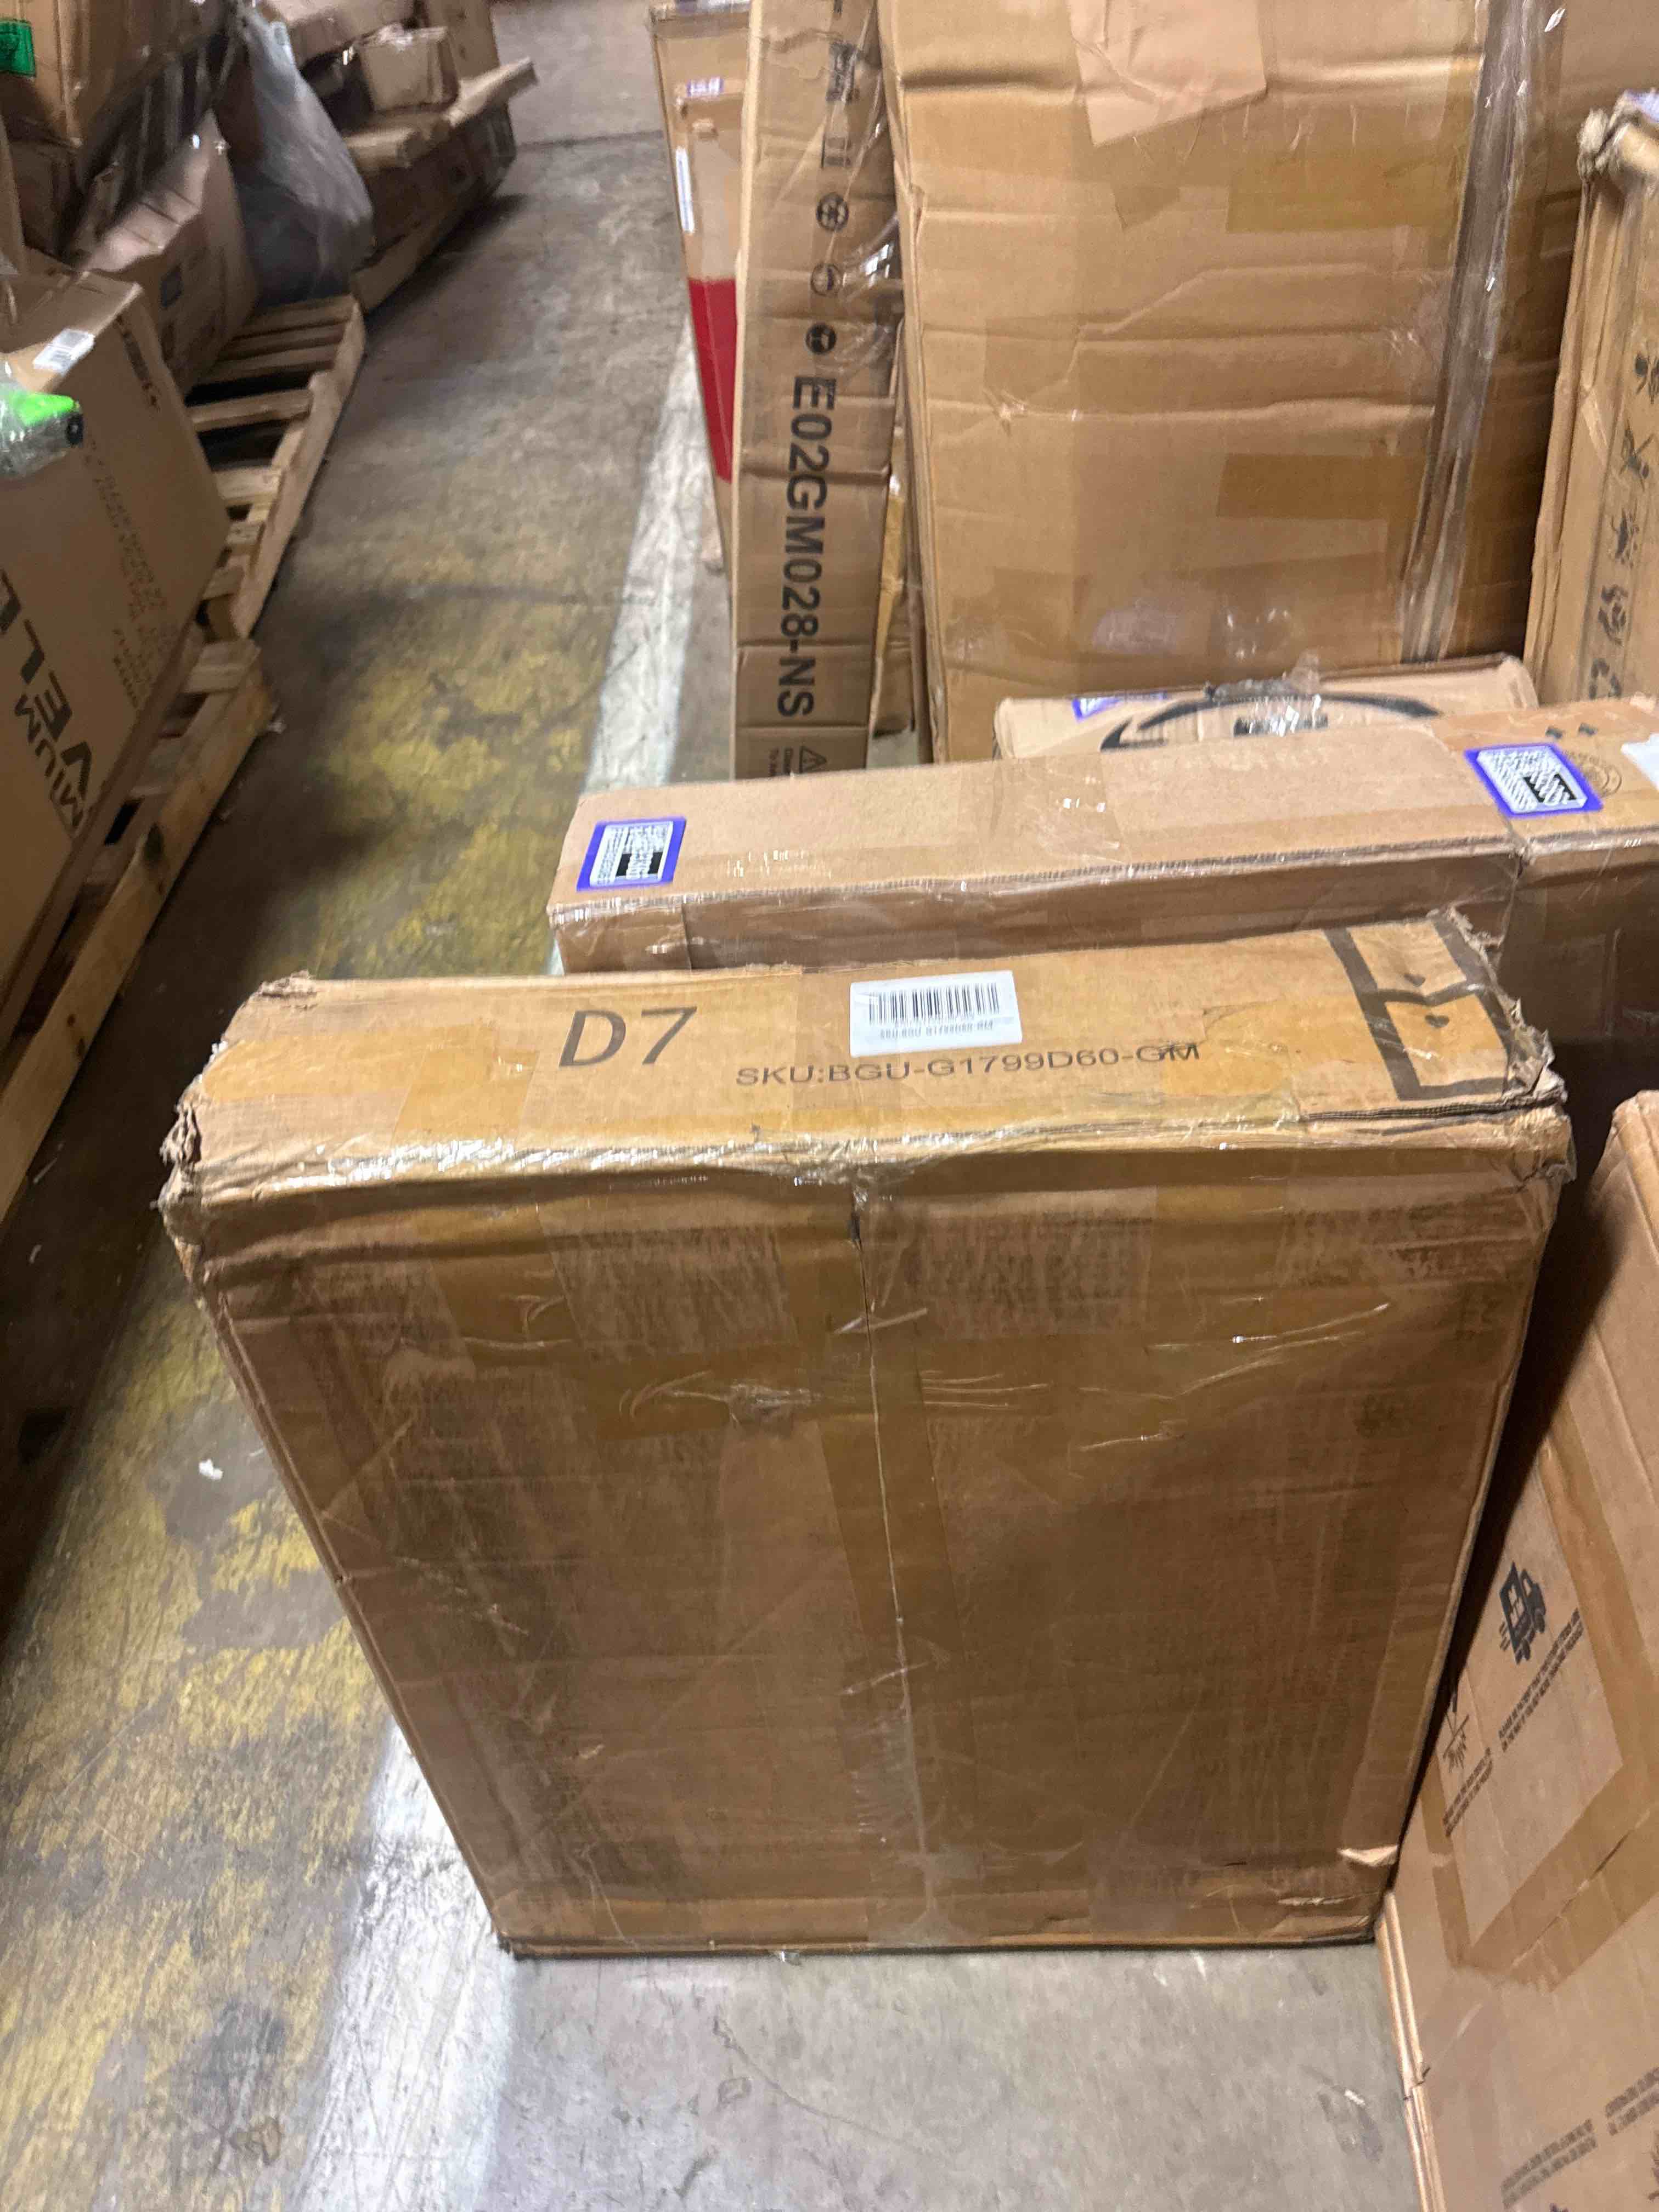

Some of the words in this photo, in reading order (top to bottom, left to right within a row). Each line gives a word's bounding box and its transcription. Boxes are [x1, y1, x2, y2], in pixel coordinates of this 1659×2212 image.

[777, 377, 837, 718] E02GM028-NS
[559, 1006, 697, 1066] D7
[735, 1043, 1200, 1086] SKU:BGU-G1799D60-GM
